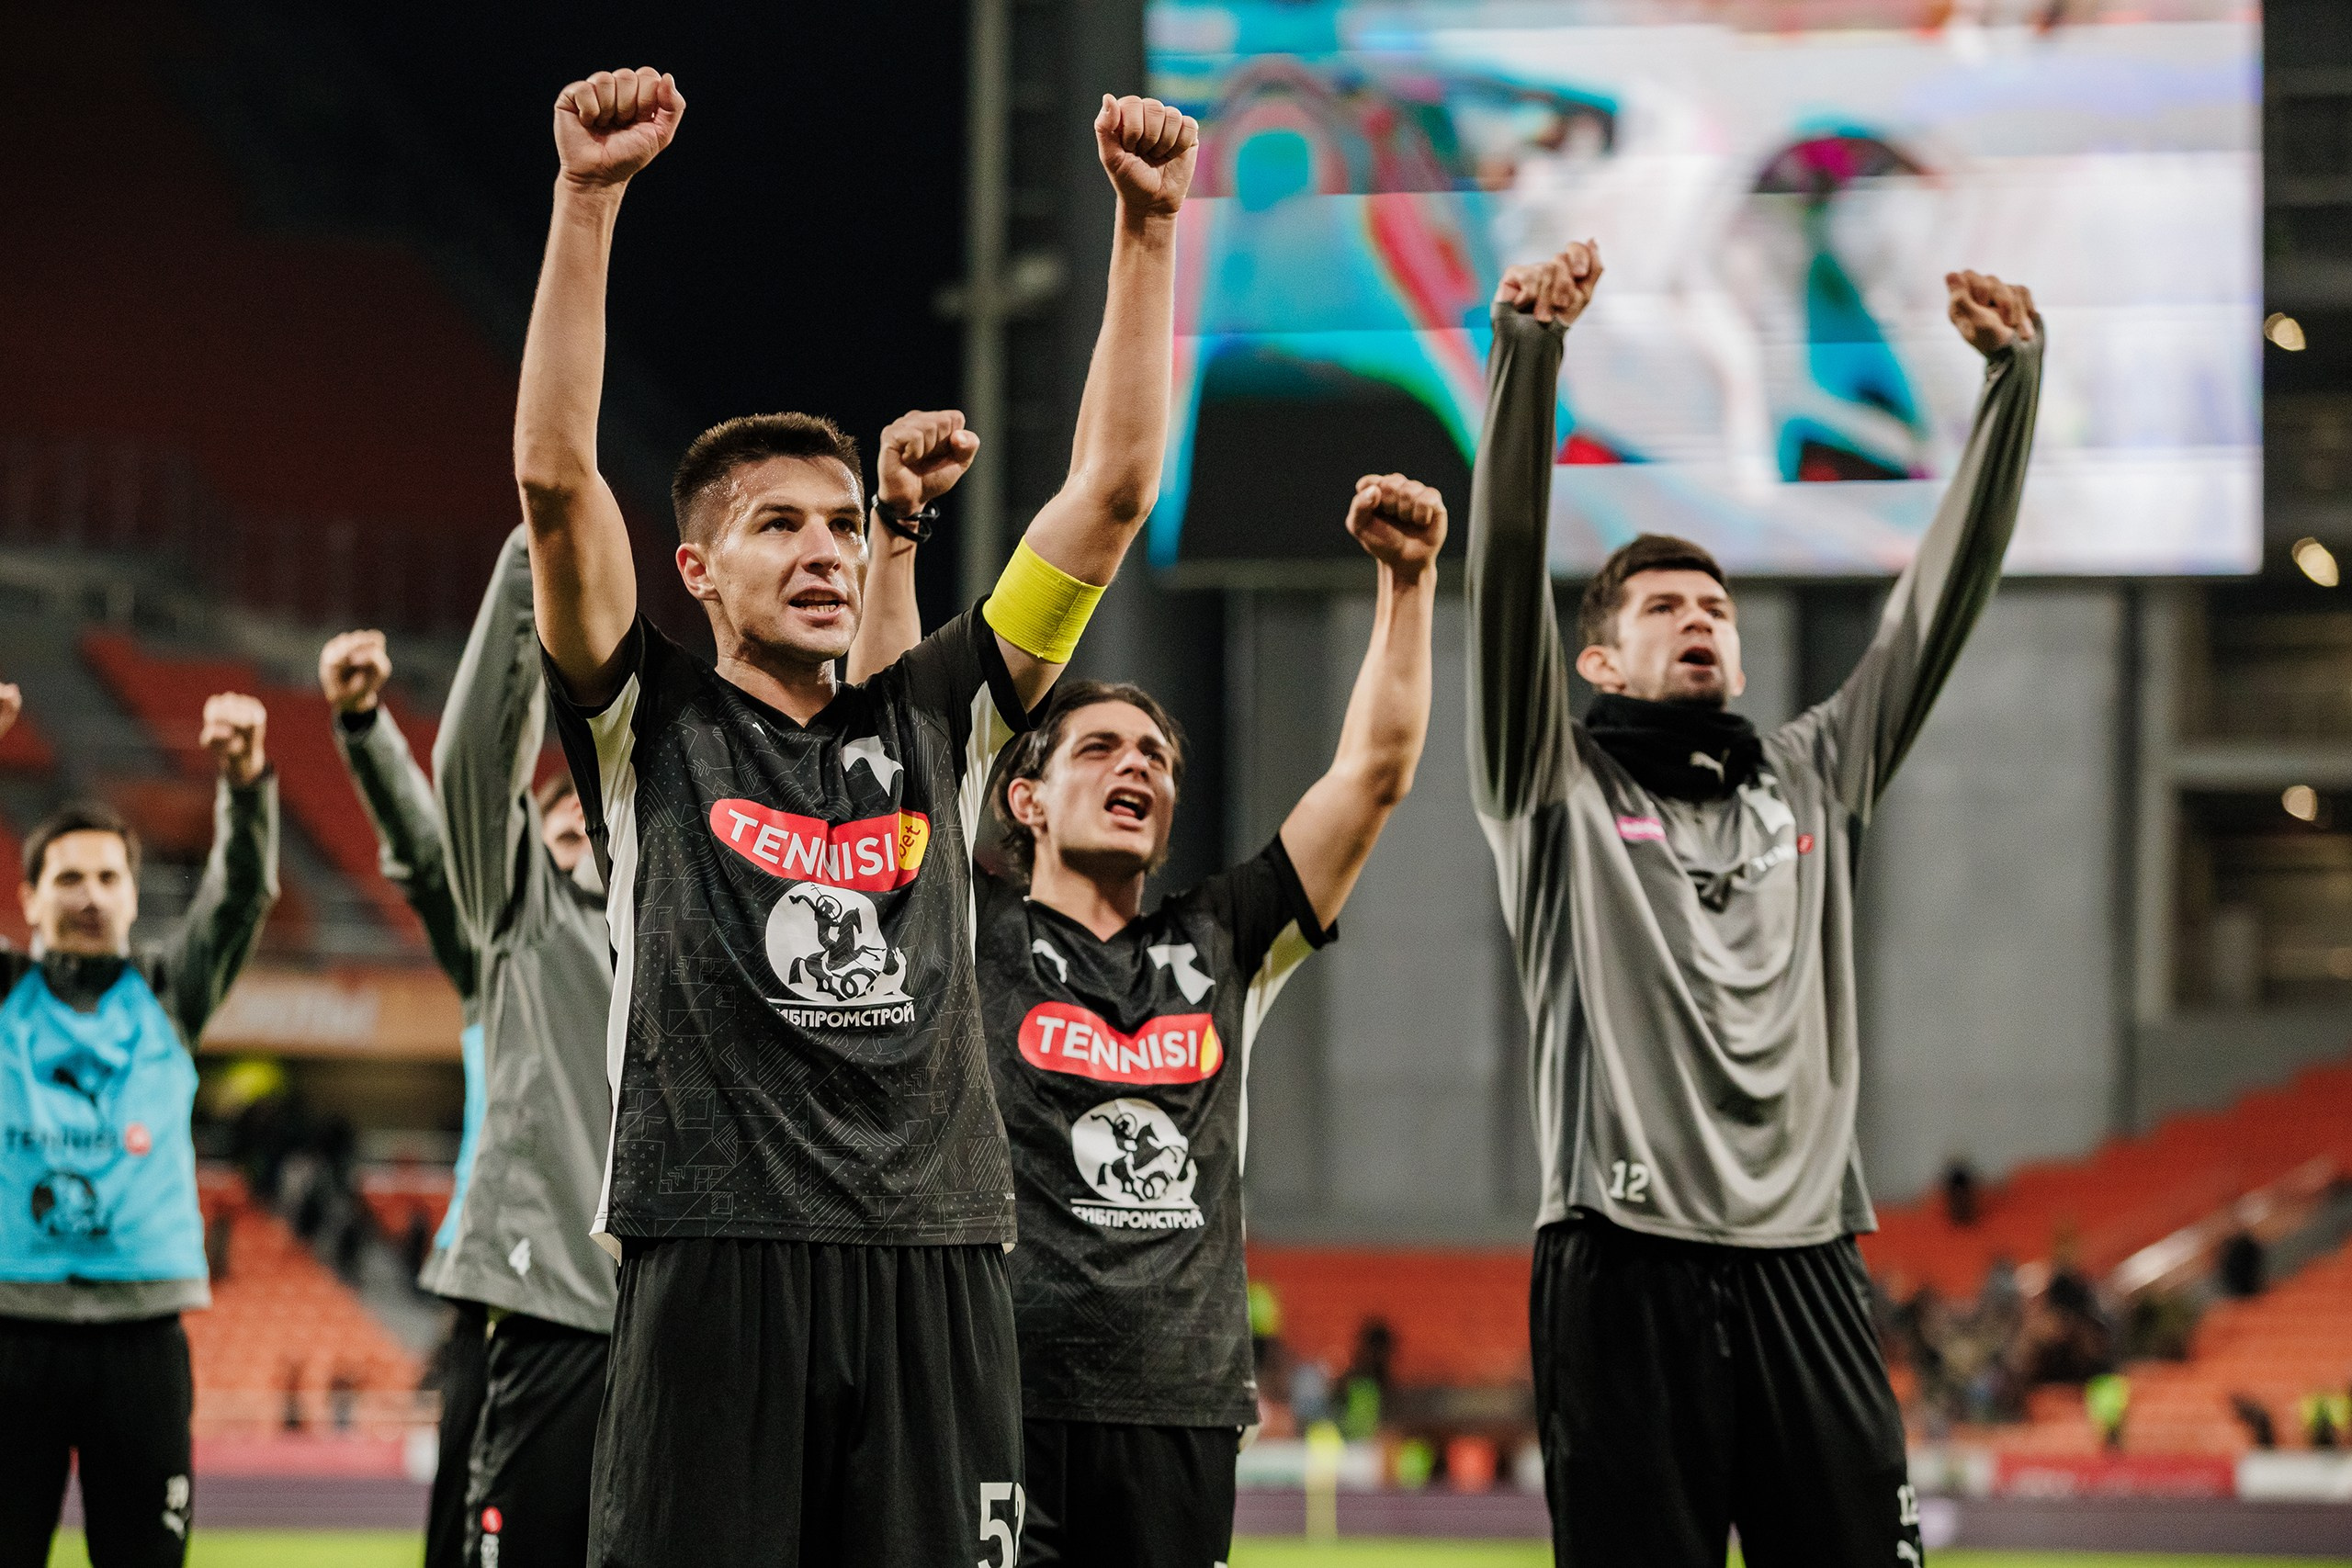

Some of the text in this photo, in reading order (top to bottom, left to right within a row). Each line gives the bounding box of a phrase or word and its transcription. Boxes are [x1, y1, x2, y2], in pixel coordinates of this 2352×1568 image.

[729, 808, 896, 882] TENNISI
[1036, 1015, 1197, 1074] TENNISI
[1610, 1159, 1649, 1202] 12
